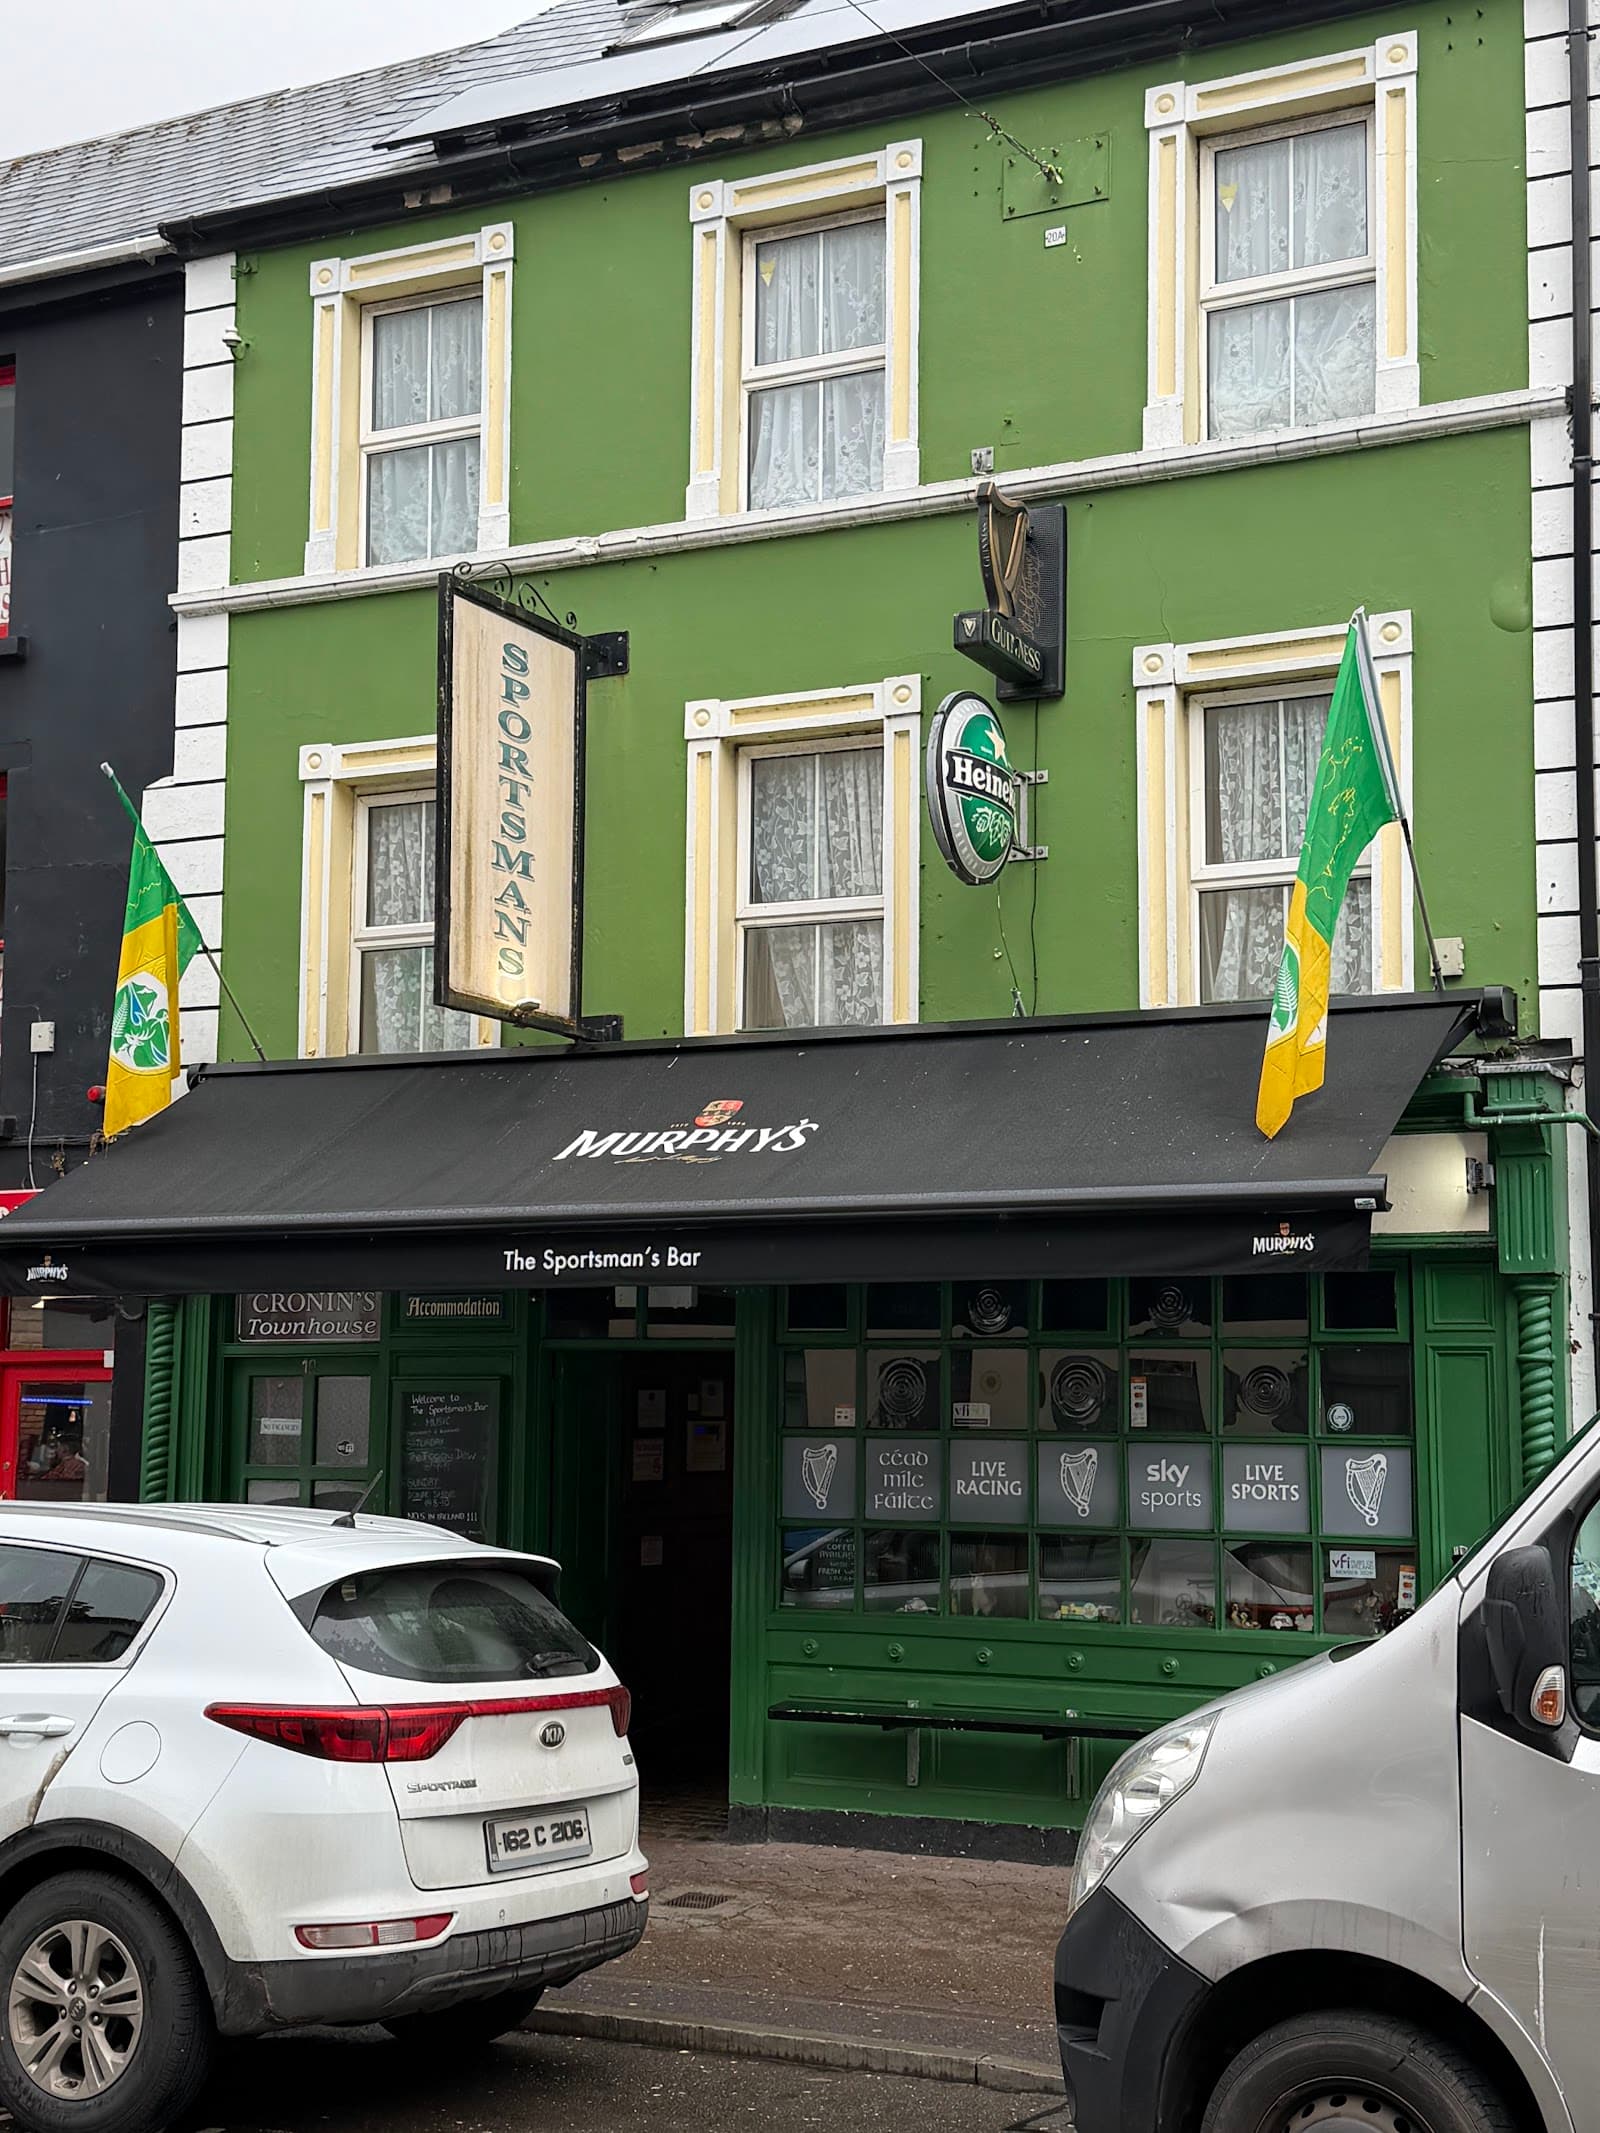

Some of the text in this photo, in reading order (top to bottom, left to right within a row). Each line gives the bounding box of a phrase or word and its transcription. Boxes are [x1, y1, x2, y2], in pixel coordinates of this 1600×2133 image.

[1047, 231, 1064, 243] 20A
[491, 642, 534, 979] SPORTSMANS
[551, 1119, 820, 1161] MURPHY'S
[1252, 1233, 1316, 1255] MURPHY'S
[503, 1246, 701, 1276] The Sportsman's Bar
[26, 1263, 69, 1282] MURPHY'S
[252, 1291, 376, 1314] CRONIN'S
[406, 1296, 500, 1317] Accommodation
[247, 1318, 377, 1336] Townhouse
[410, 1405, 424, 1415] The
[473, 1401, 489, 1411] Bar
[411, 1393, 460, 1405] Welcome to
[971, 1461, 1007, 1477] LIVE
[1146, 1458, 1190, 1488] sky
[1245, 1464, 1284, 1481] LIVE
[956, 1479, 1022, 1496] RACING
[1231, 1483, 1300, 1501] SPORTS
[1141, 1490, 1202, 1513] sports
[1332, 1553, 1351, 1569] vfi
[545, 1726, 564, 1743] KIA
[502, 1819, 584, 1853] 162 C 2106
